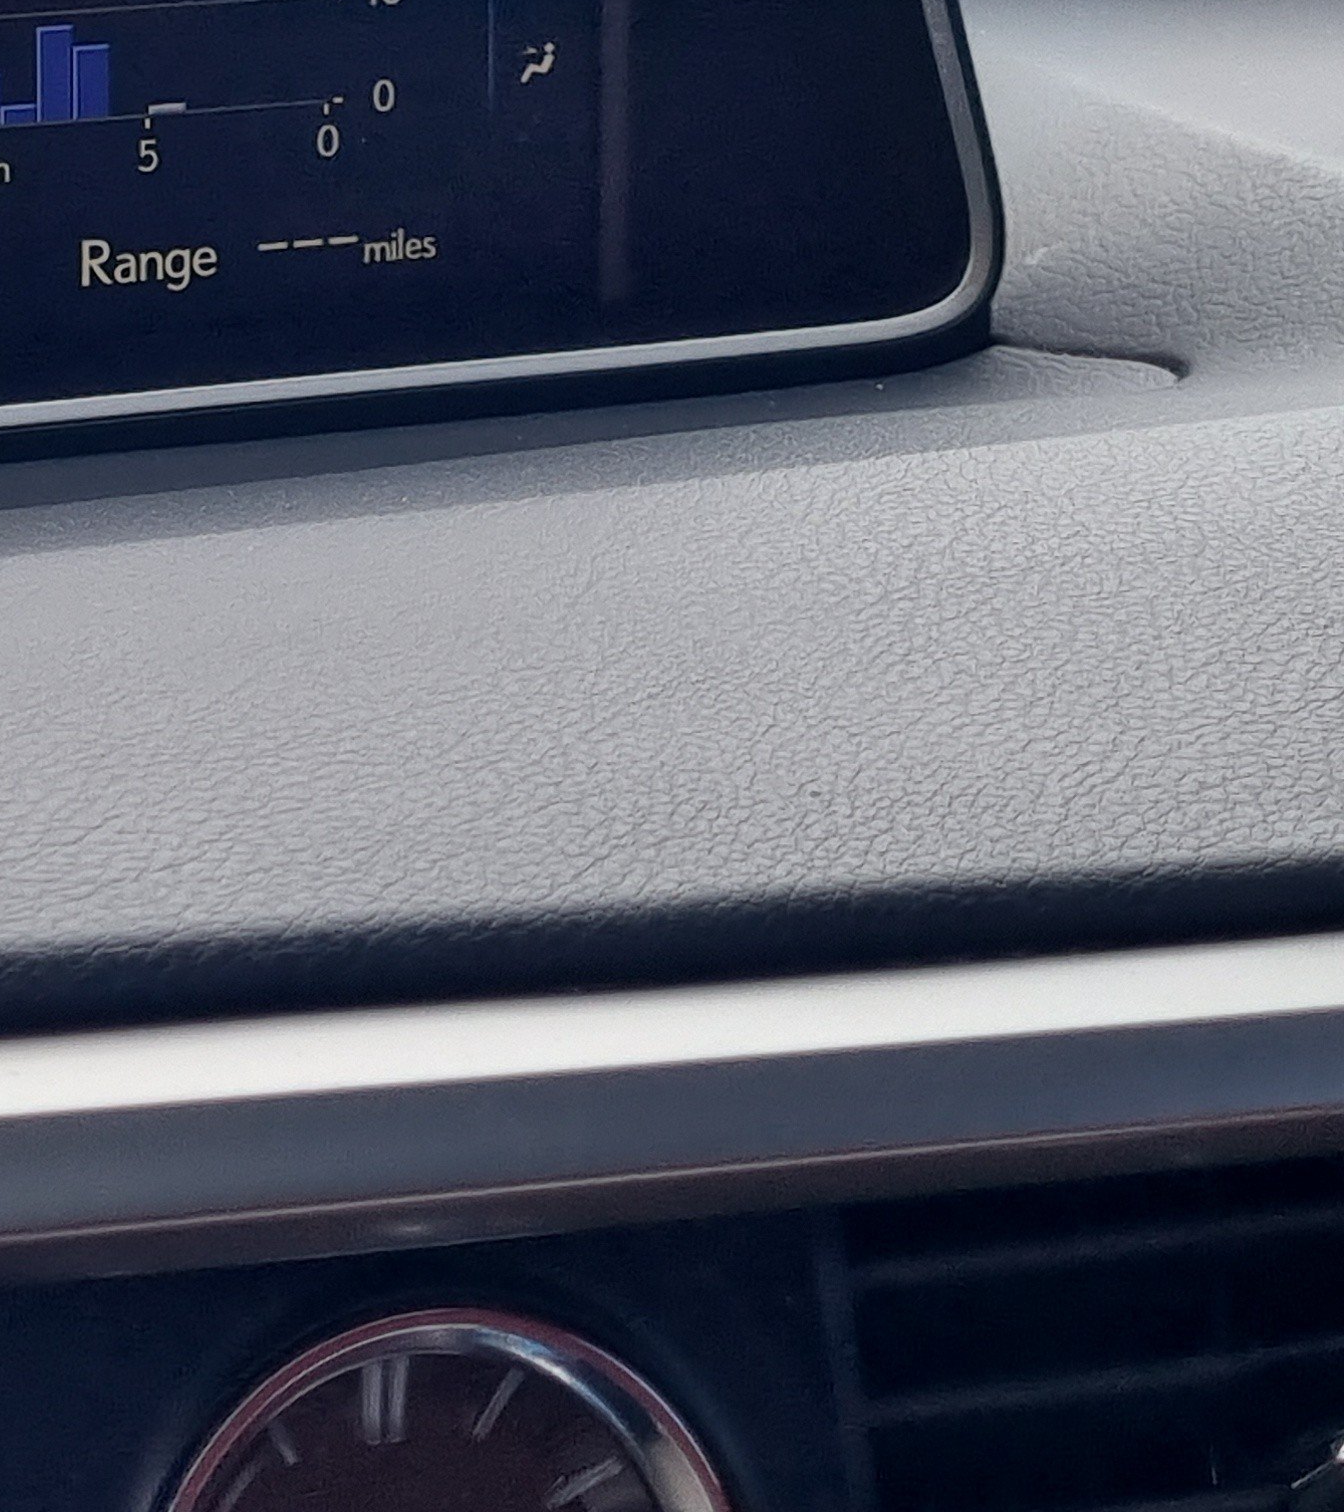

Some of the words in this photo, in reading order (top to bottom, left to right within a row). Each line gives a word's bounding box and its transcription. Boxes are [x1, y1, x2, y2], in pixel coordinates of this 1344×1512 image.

[372, 80, 396, 113] 0
[138, 138, 159, 174] 5
[316, 125, 340, 159] 0
[79, 238, 218, 292] Range
